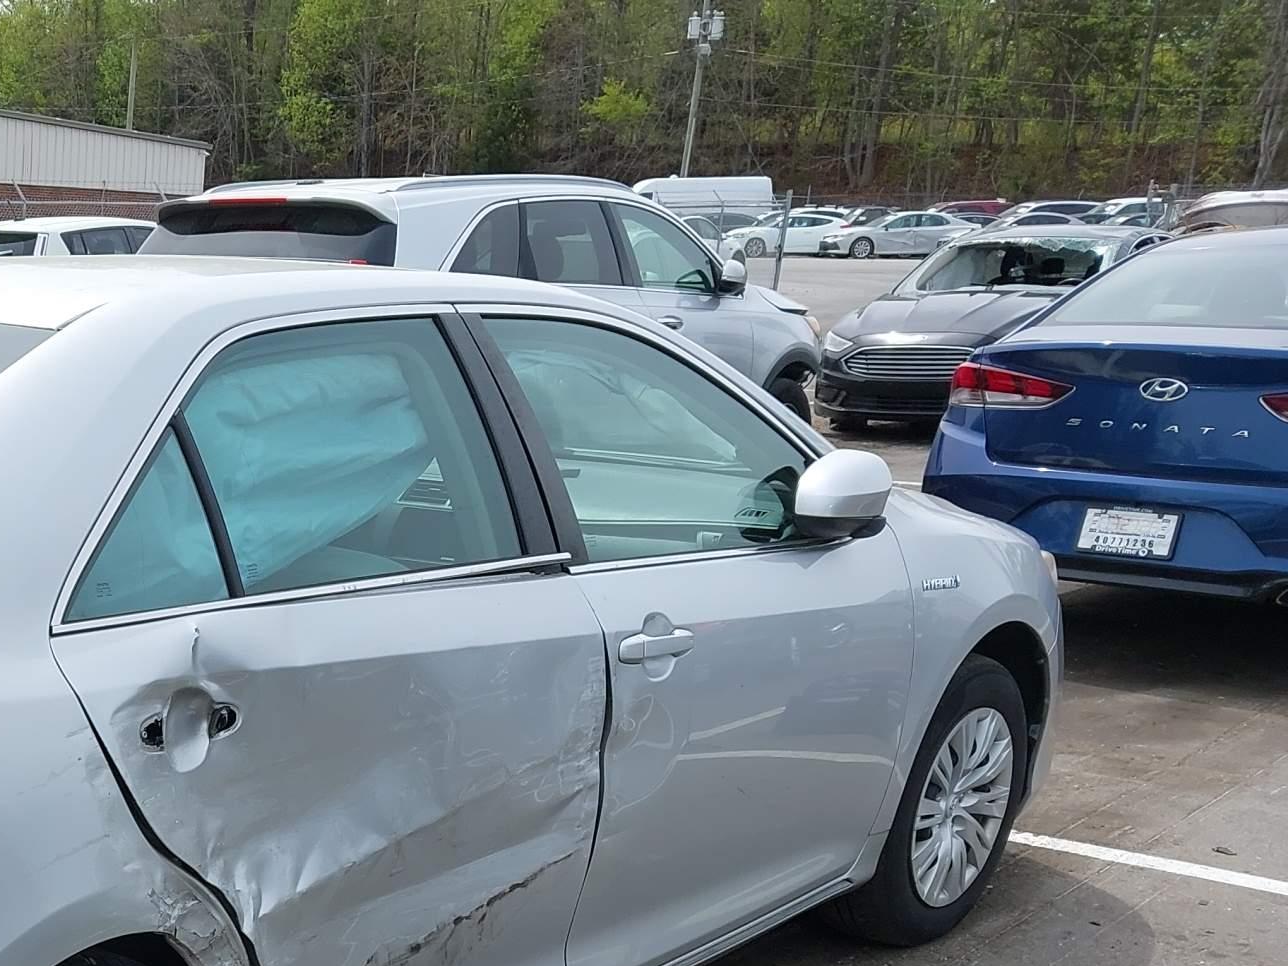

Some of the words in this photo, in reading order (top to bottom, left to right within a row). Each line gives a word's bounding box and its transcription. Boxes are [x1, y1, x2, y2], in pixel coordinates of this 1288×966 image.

[1066, 418, 1249, 438] SONATA
[1094, 535, 1154, 548] 40771236
[1095, 545, 1138, 555] DriveTime
